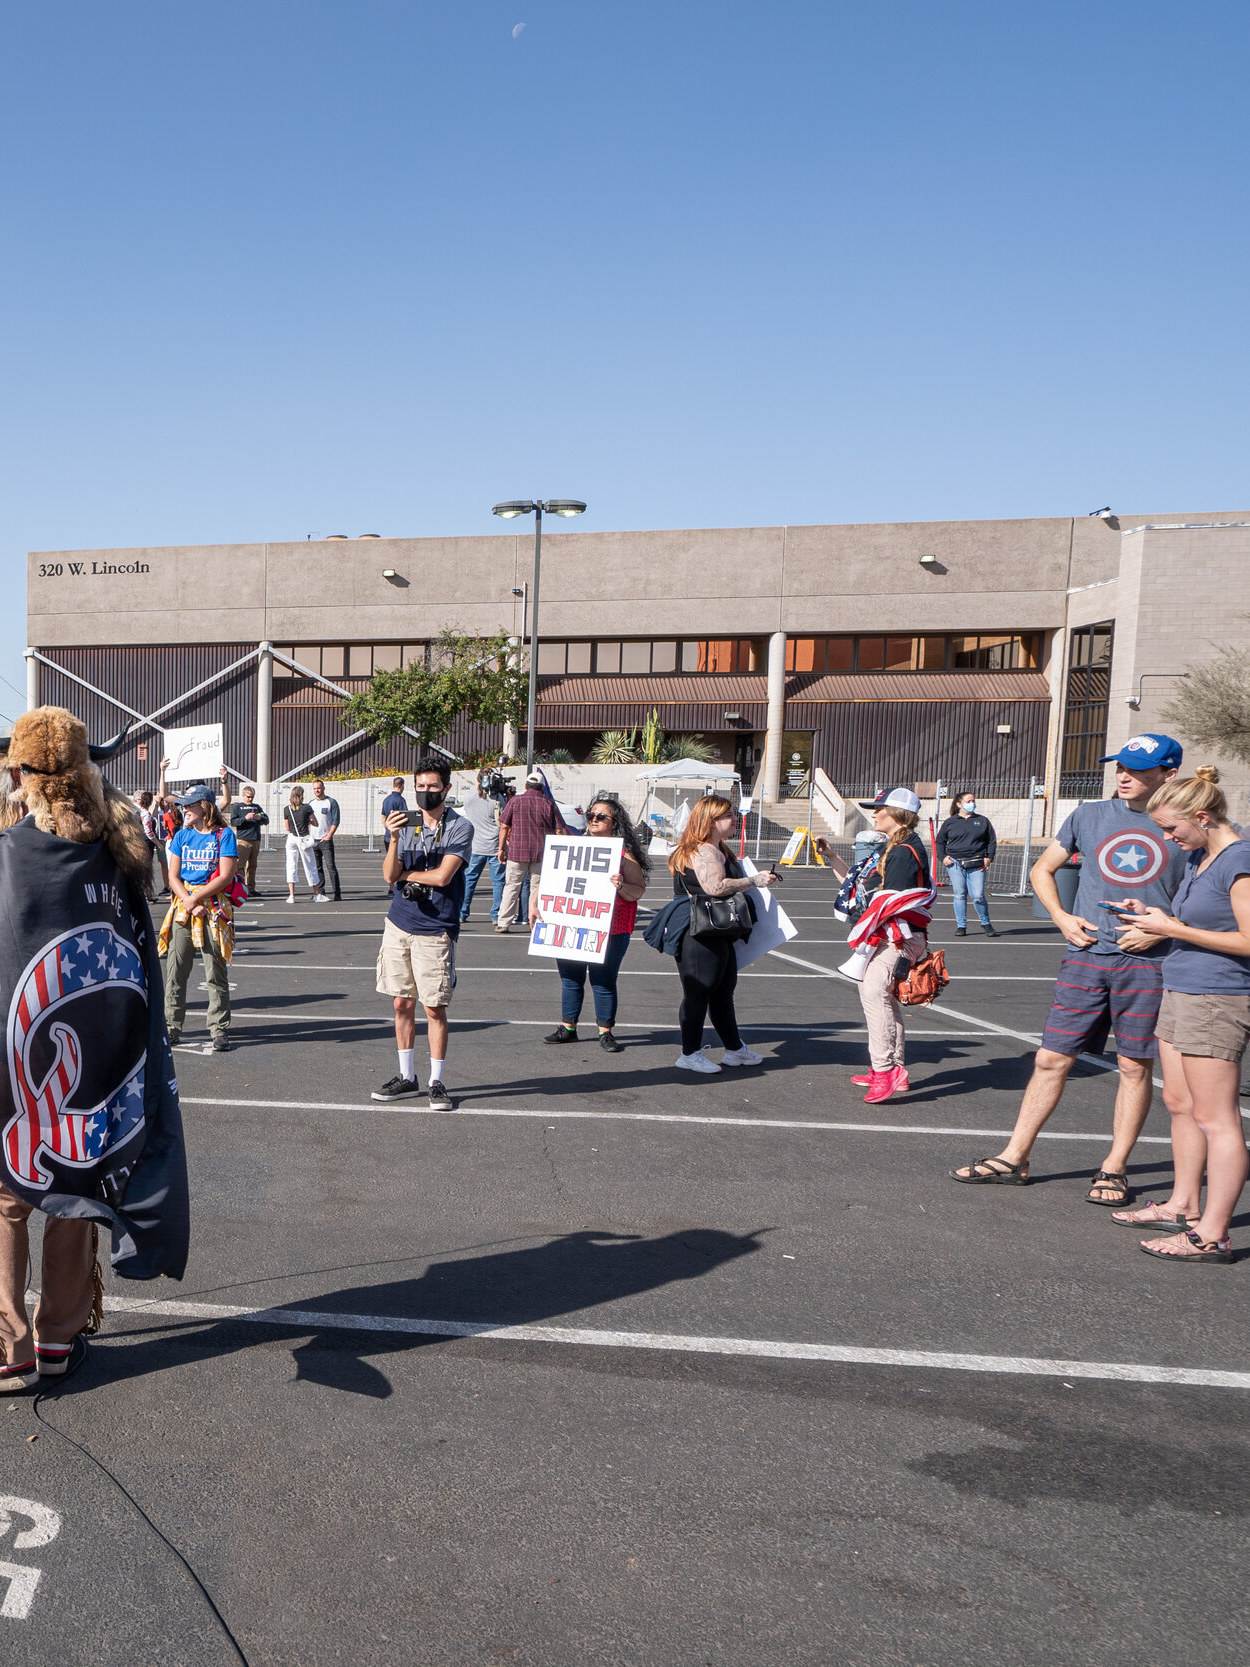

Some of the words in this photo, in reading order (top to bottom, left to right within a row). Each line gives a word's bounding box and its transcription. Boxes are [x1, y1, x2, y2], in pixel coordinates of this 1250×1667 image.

[38, 563, 63, 577] 320
[67, 562, 86, 576] W.
[91, 560, 150, 575] Lincoln
[190, 733, 220, 751] Fraud
[550, 845, 612, 873] THIS
[565, 877, 587, 895] IS
[84, 883, 123, 918] WHEE
[541, 894, 611, 919] TRUMP
[533, 922, 607, 953] COUNTRY
